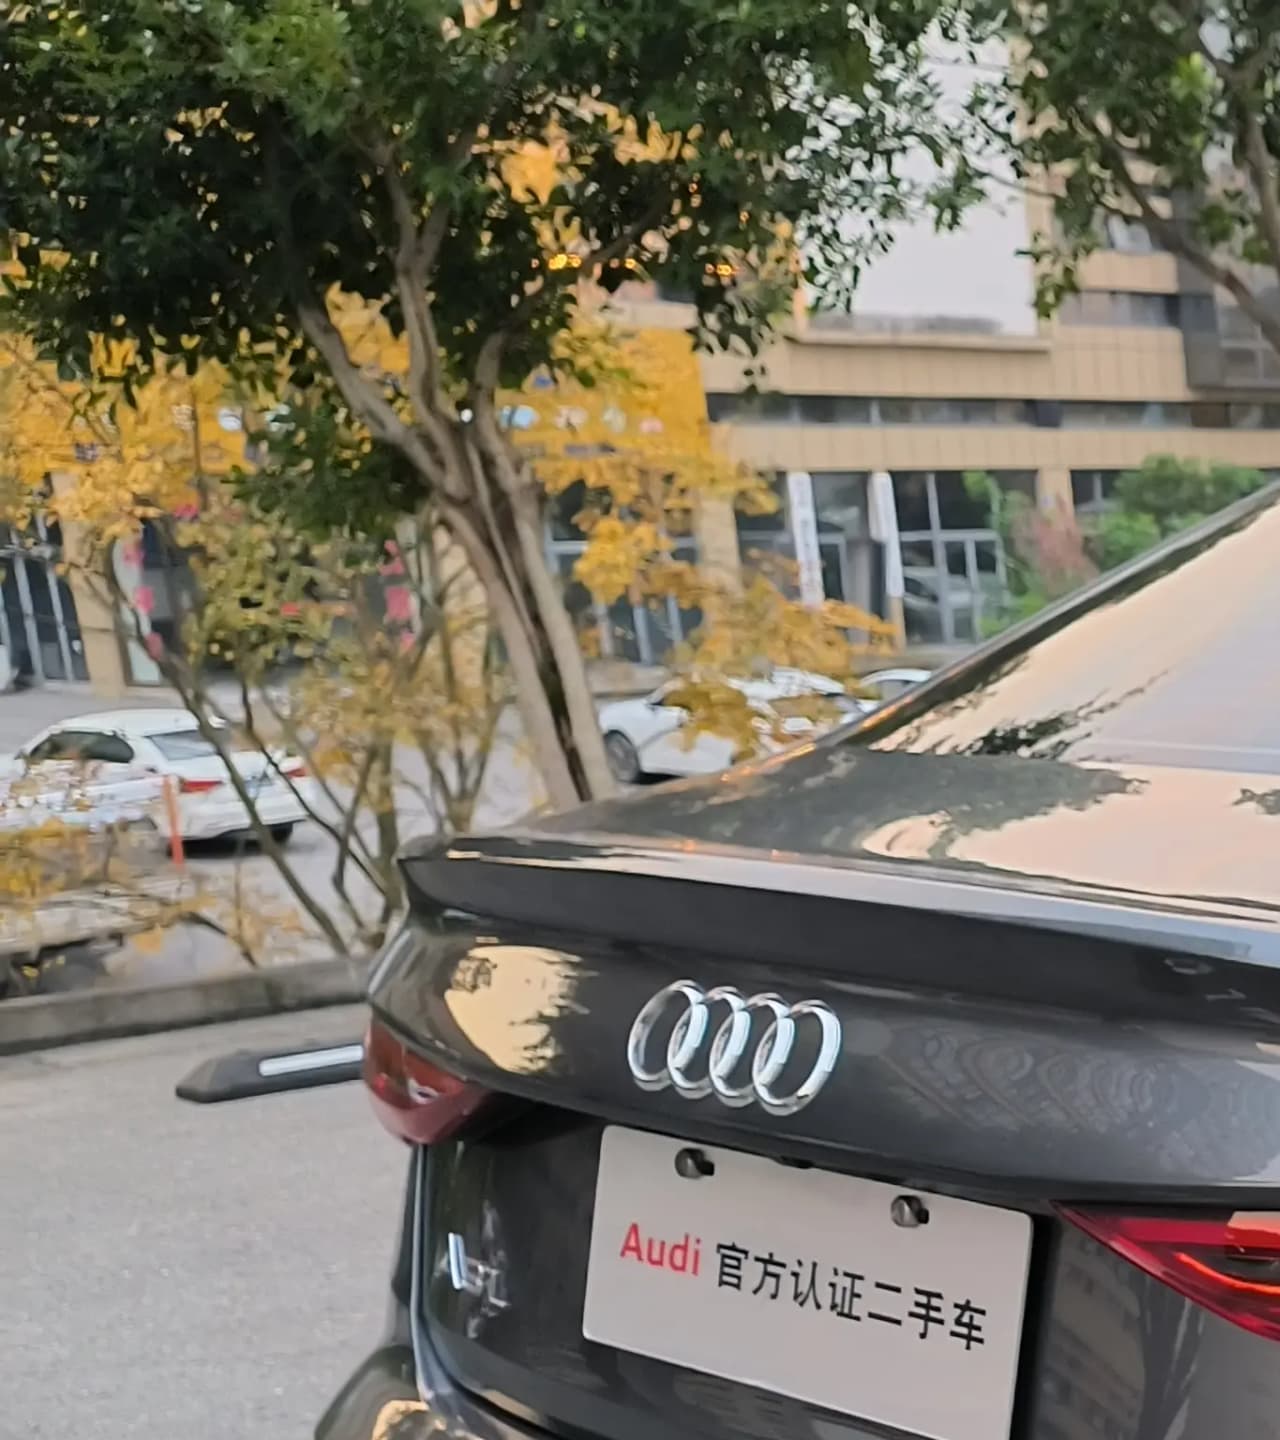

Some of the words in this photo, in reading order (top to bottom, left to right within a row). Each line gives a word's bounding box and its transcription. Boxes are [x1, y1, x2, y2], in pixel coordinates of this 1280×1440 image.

[619, 1223, 701, 1276] Audi
[715, 1242, 987, 1351] 官方认证二手车
